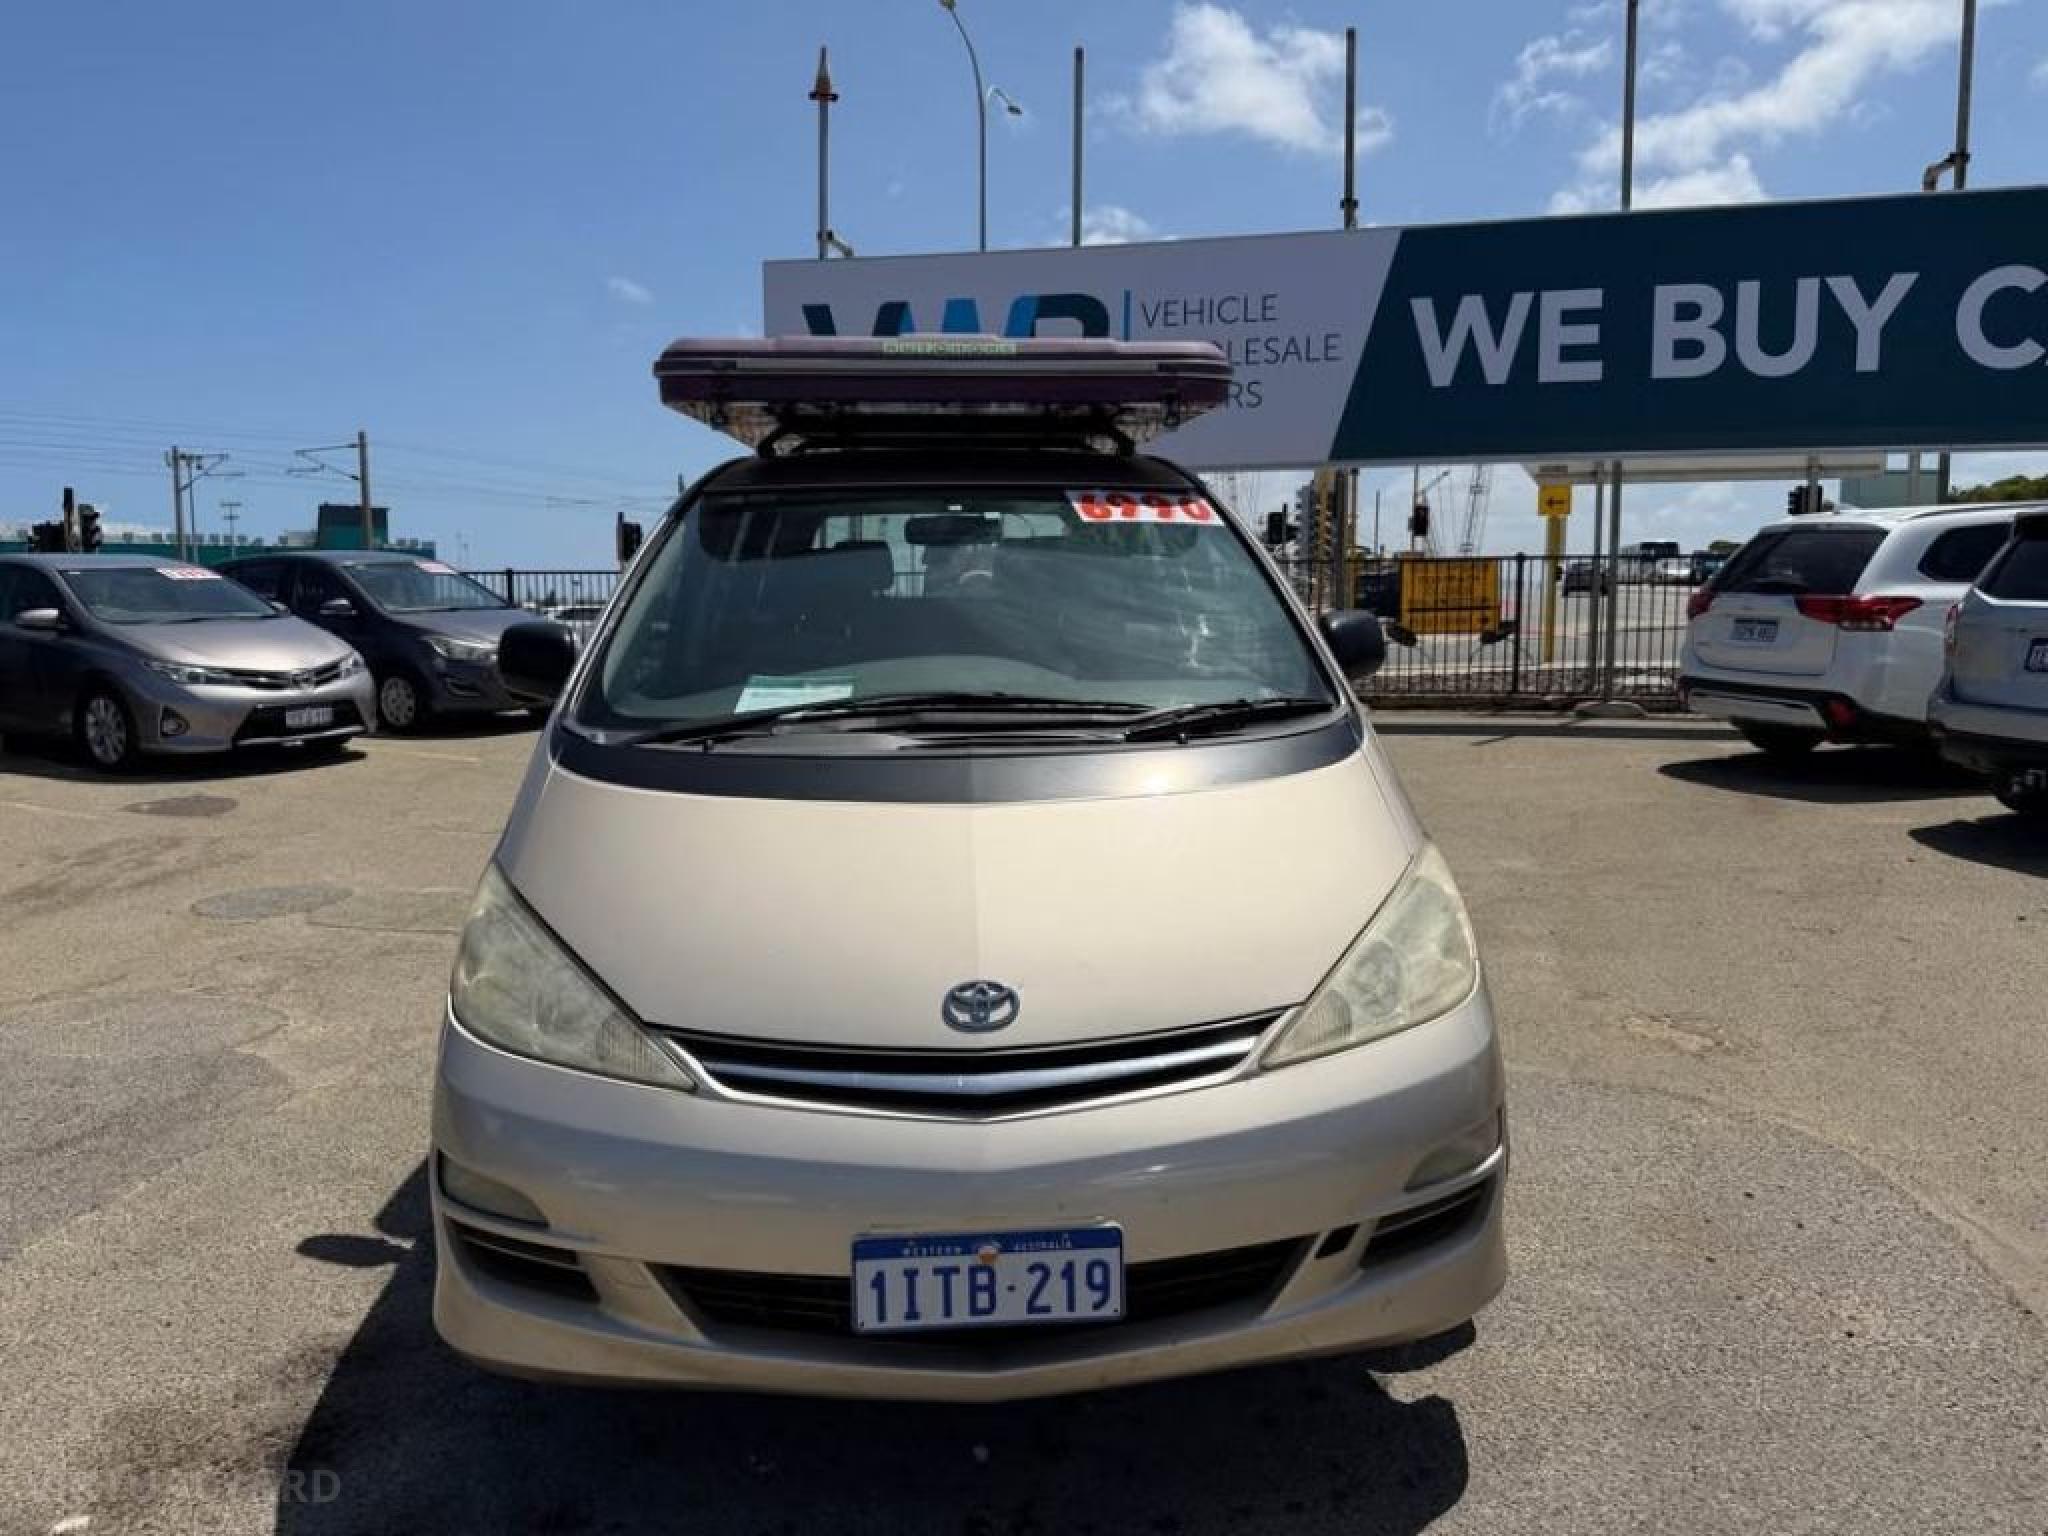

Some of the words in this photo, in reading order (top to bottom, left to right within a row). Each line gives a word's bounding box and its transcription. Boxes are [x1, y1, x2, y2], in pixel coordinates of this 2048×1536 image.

[1141, 293, 1280, 327] VEHICLE
[1410, 288, 1604, 387] WE
[1651, 272, 1920, 379] BUY
[1955, 264, 2048, 371] C
[1212, 333, 1343, 366] LESALE
